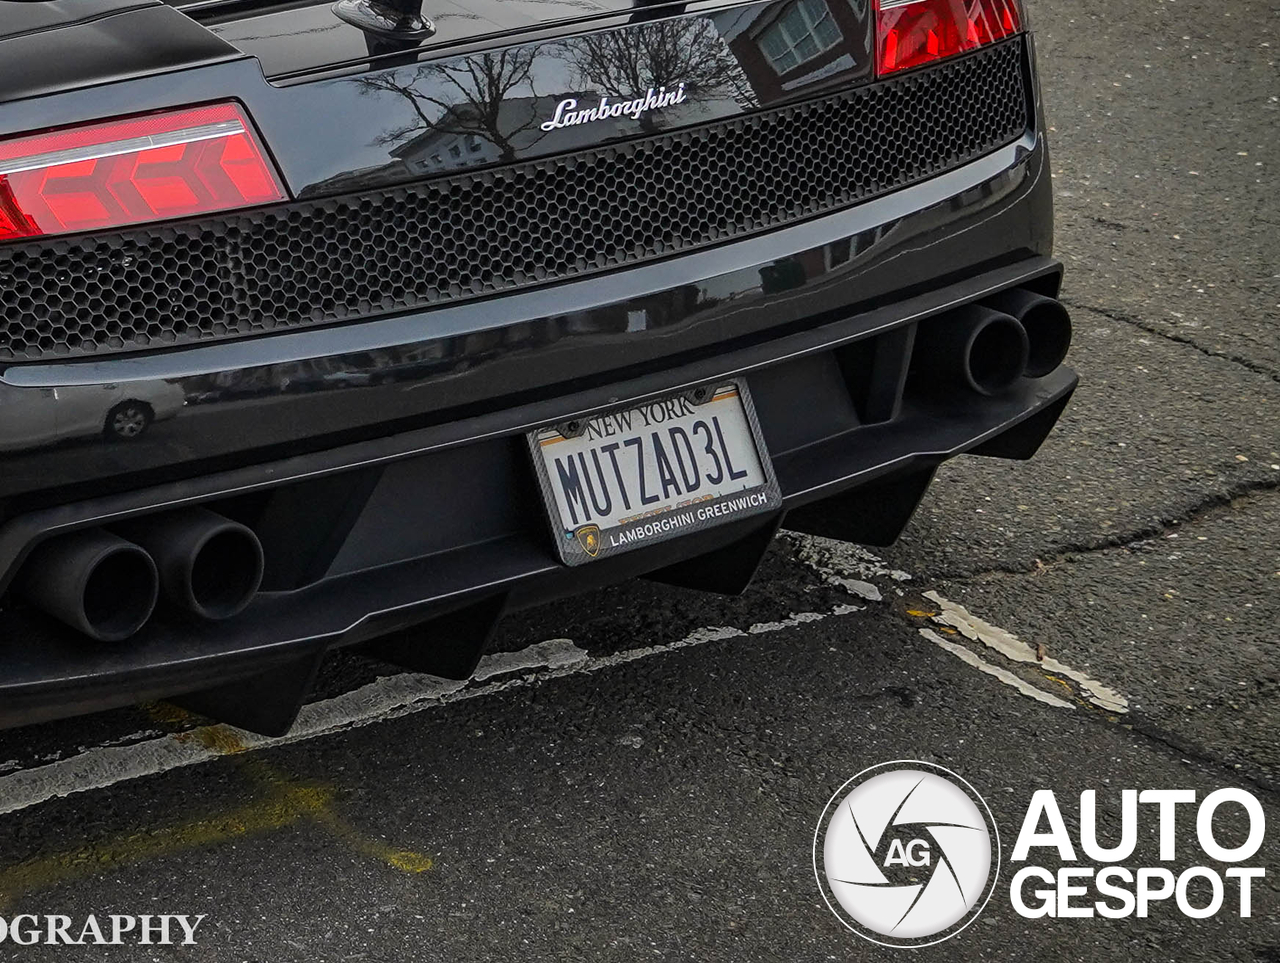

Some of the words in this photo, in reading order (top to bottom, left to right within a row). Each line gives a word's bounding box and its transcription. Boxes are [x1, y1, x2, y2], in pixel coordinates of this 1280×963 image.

[540, 82, 687, 132] Lamborghini
[585, 411, 640, 442] NEW
[640, 396, 696, 428] YORK
[554, 416, 748, 525] MUTZAD3L
[610, 511, 696, 547] LAMBORGHINI
[697, 492, 768, 521] GREENWICH
